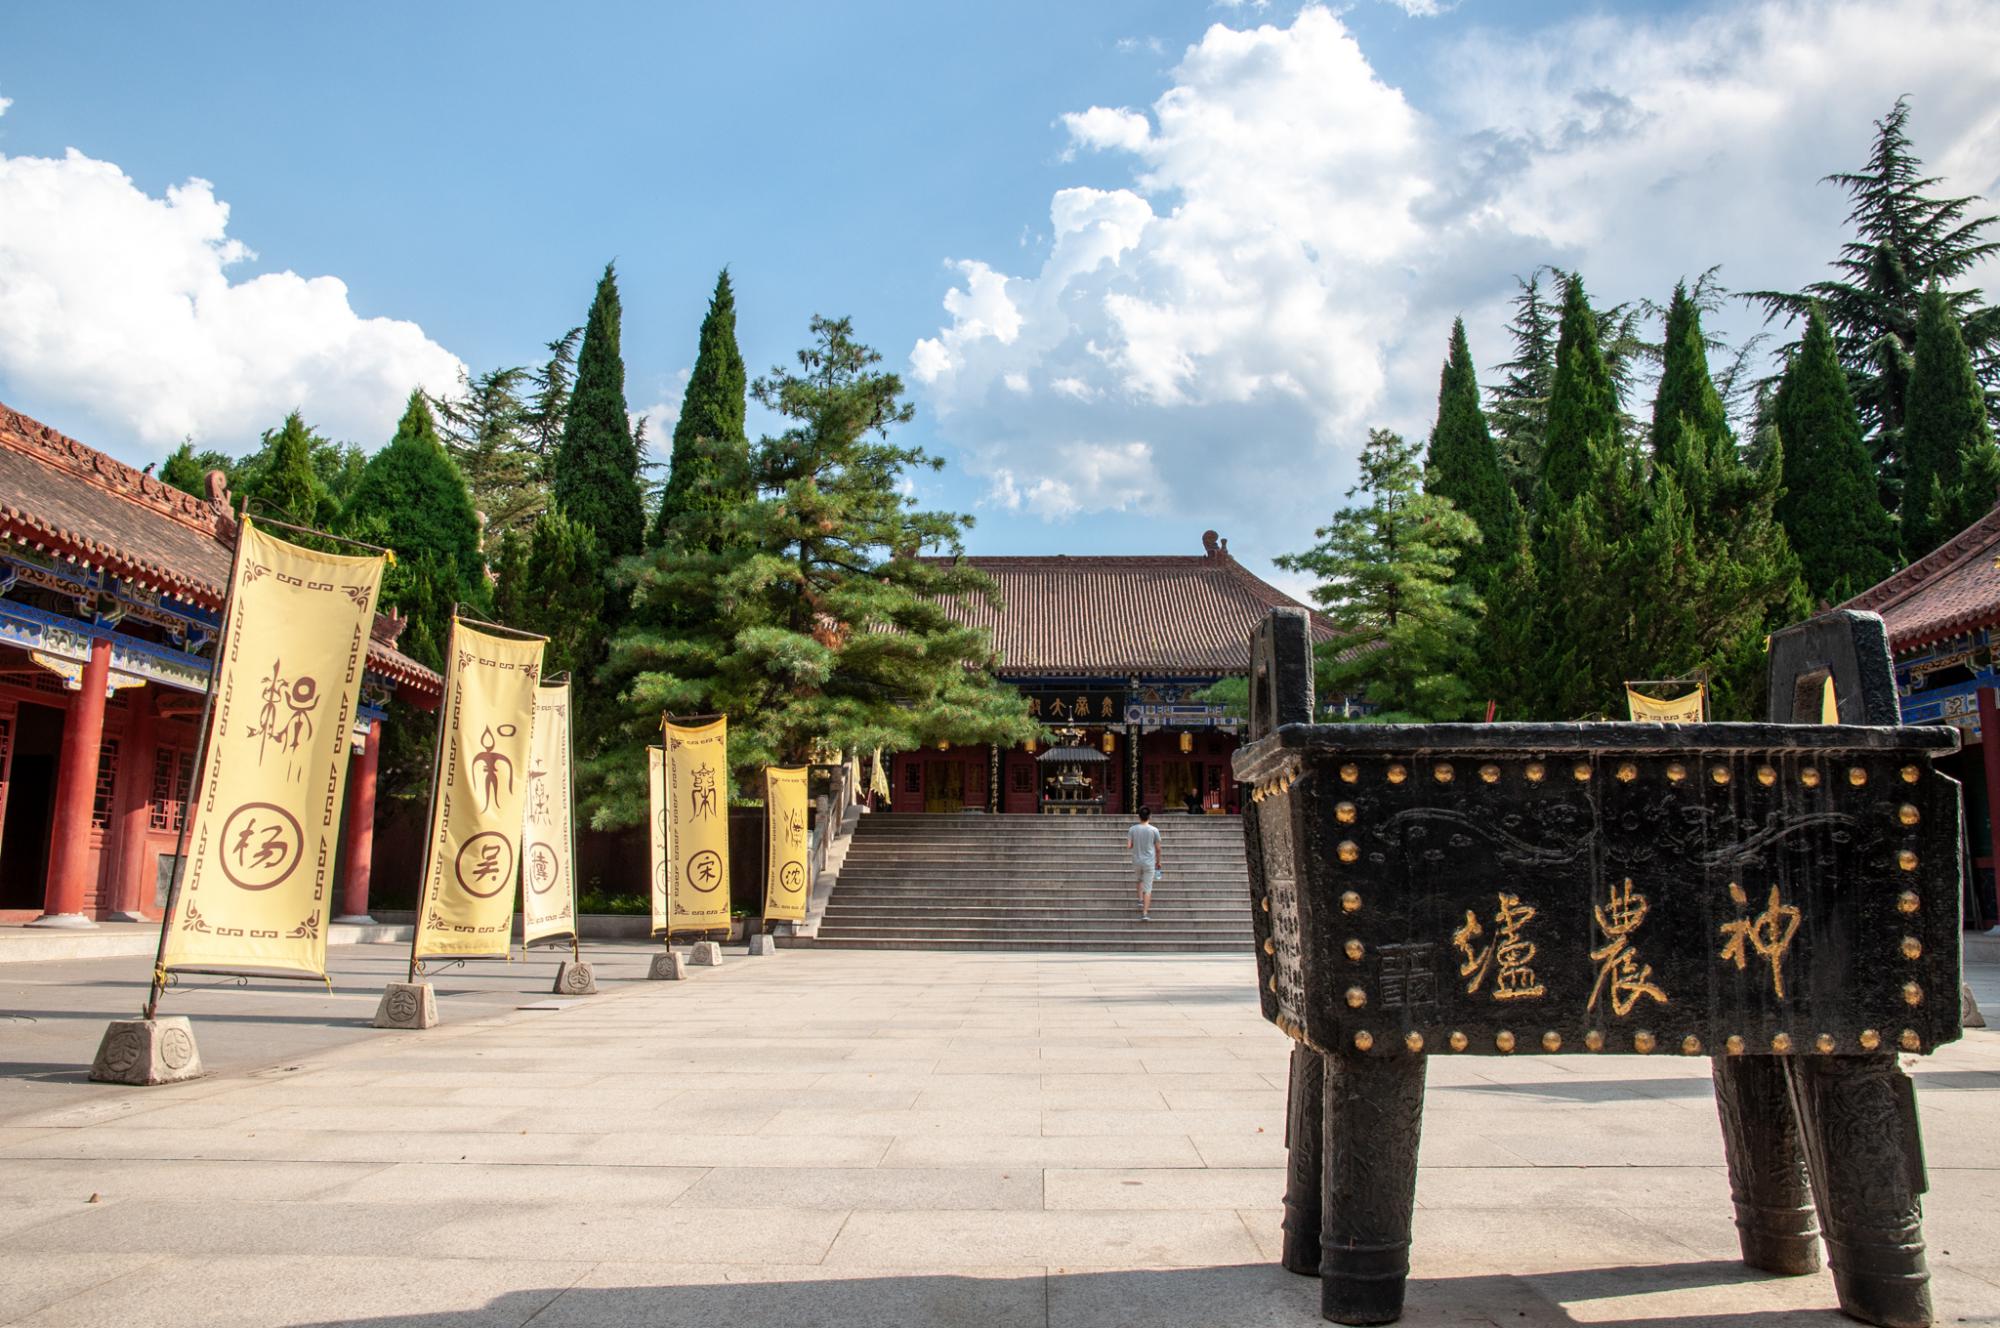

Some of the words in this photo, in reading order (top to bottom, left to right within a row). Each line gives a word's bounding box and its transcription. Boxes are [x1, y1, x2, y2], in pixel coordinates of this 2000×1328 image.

[232, 818, 288, 869] 杨
[472, 844, 501, 882] 吴
[697, 856, 716, 883] 宋
[785, 867, 801, 885] 沈
